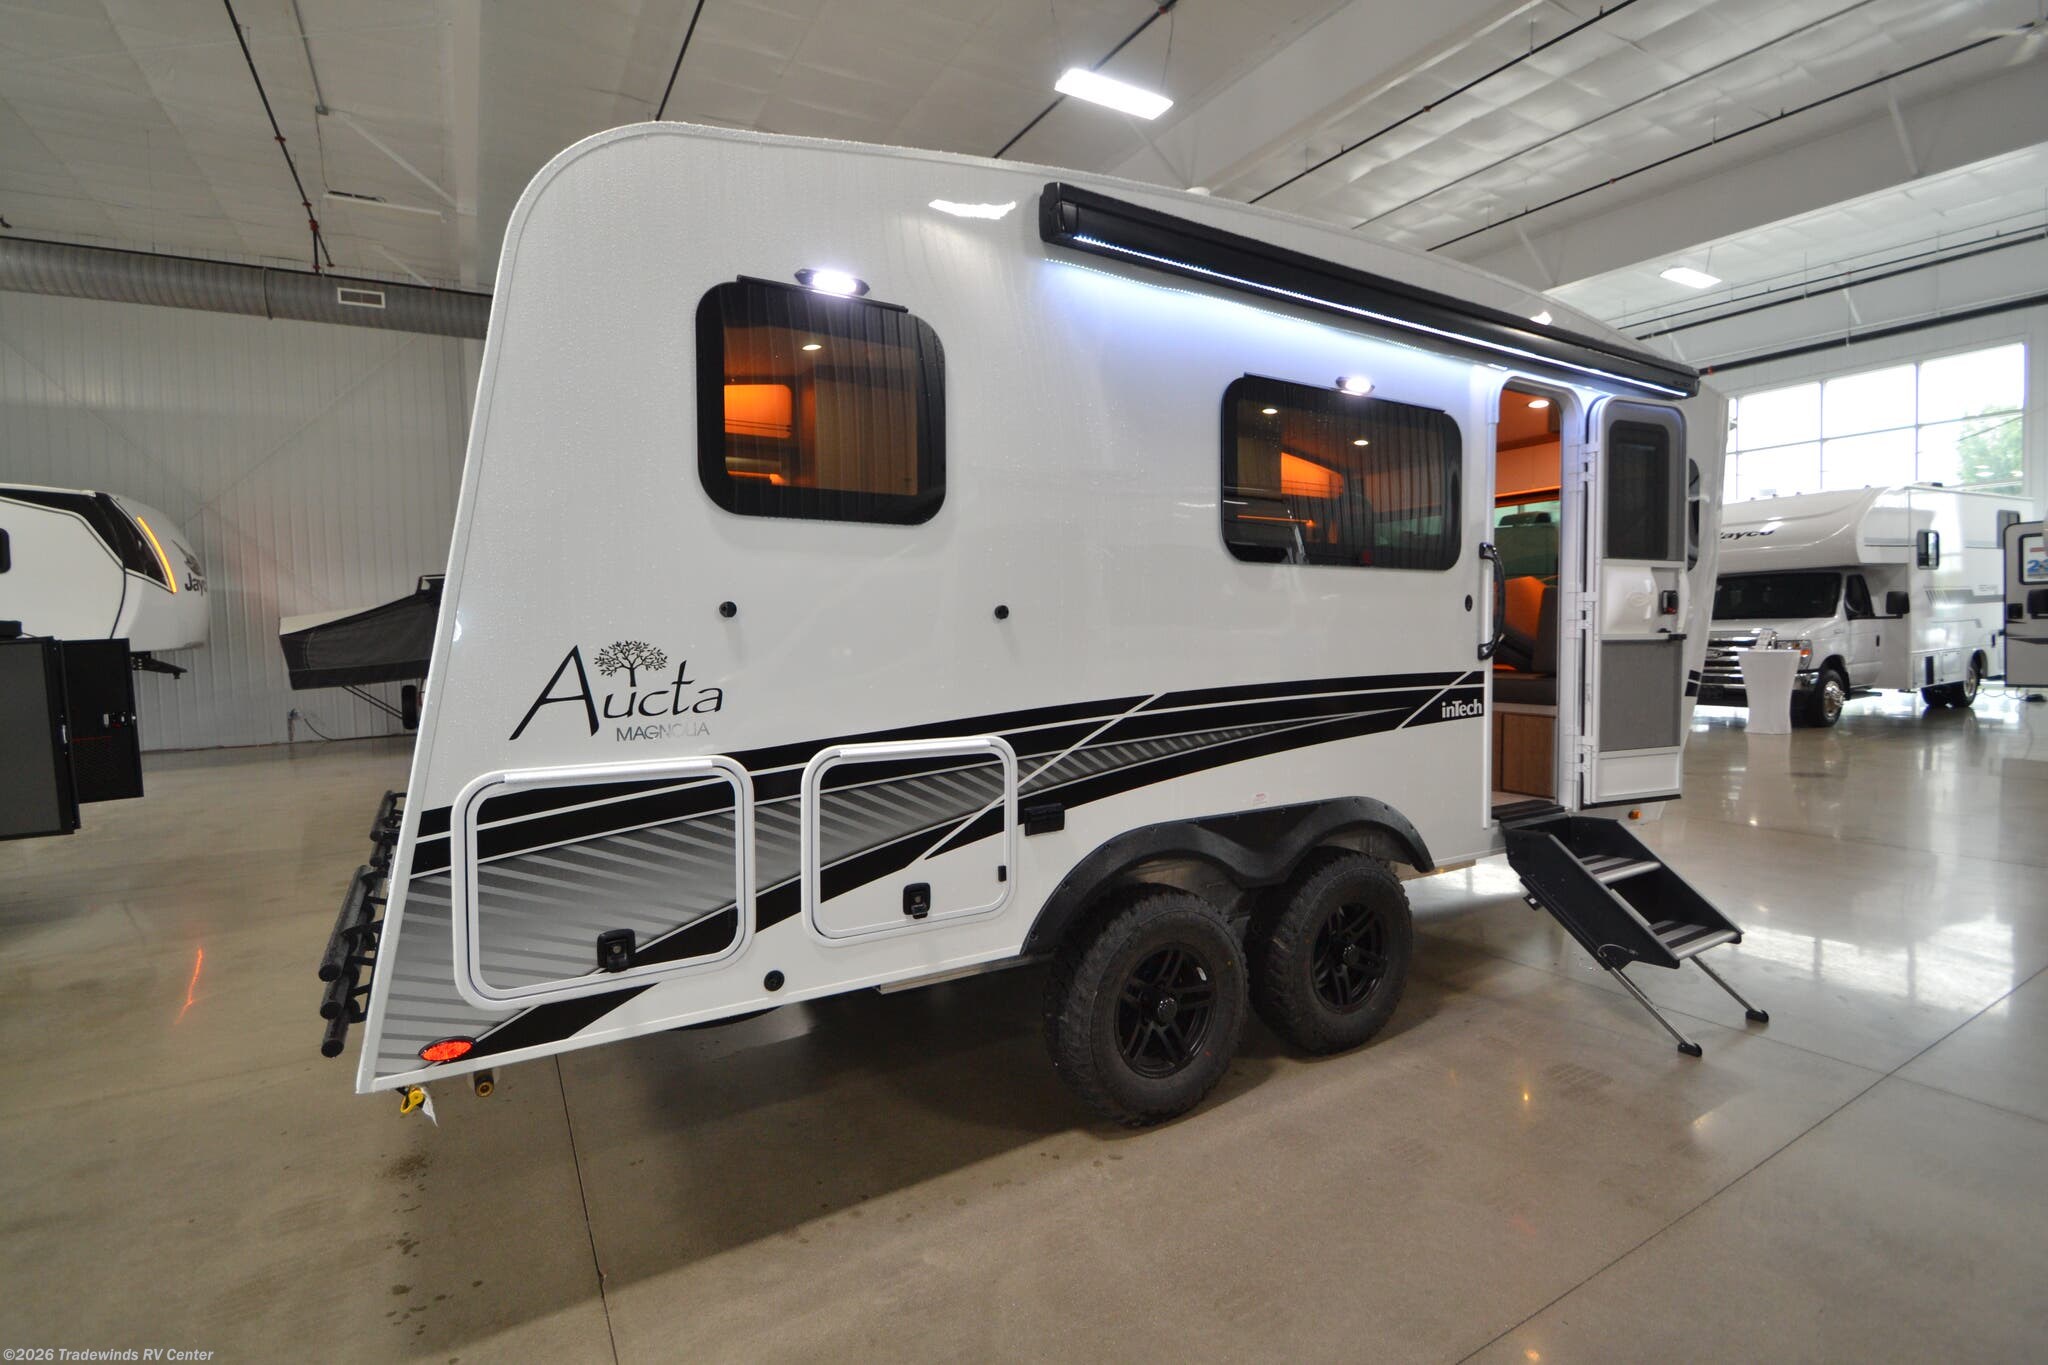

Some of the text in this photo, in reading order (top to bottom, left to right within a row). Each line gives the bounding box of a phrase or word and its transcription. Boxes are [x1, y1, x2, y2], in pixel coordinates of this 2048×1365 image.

[508, 644, 723, 741] Aucta
[1441, 698, 1483, 719] inTech
[616, 721, 711, 742] MAGNOLIA
